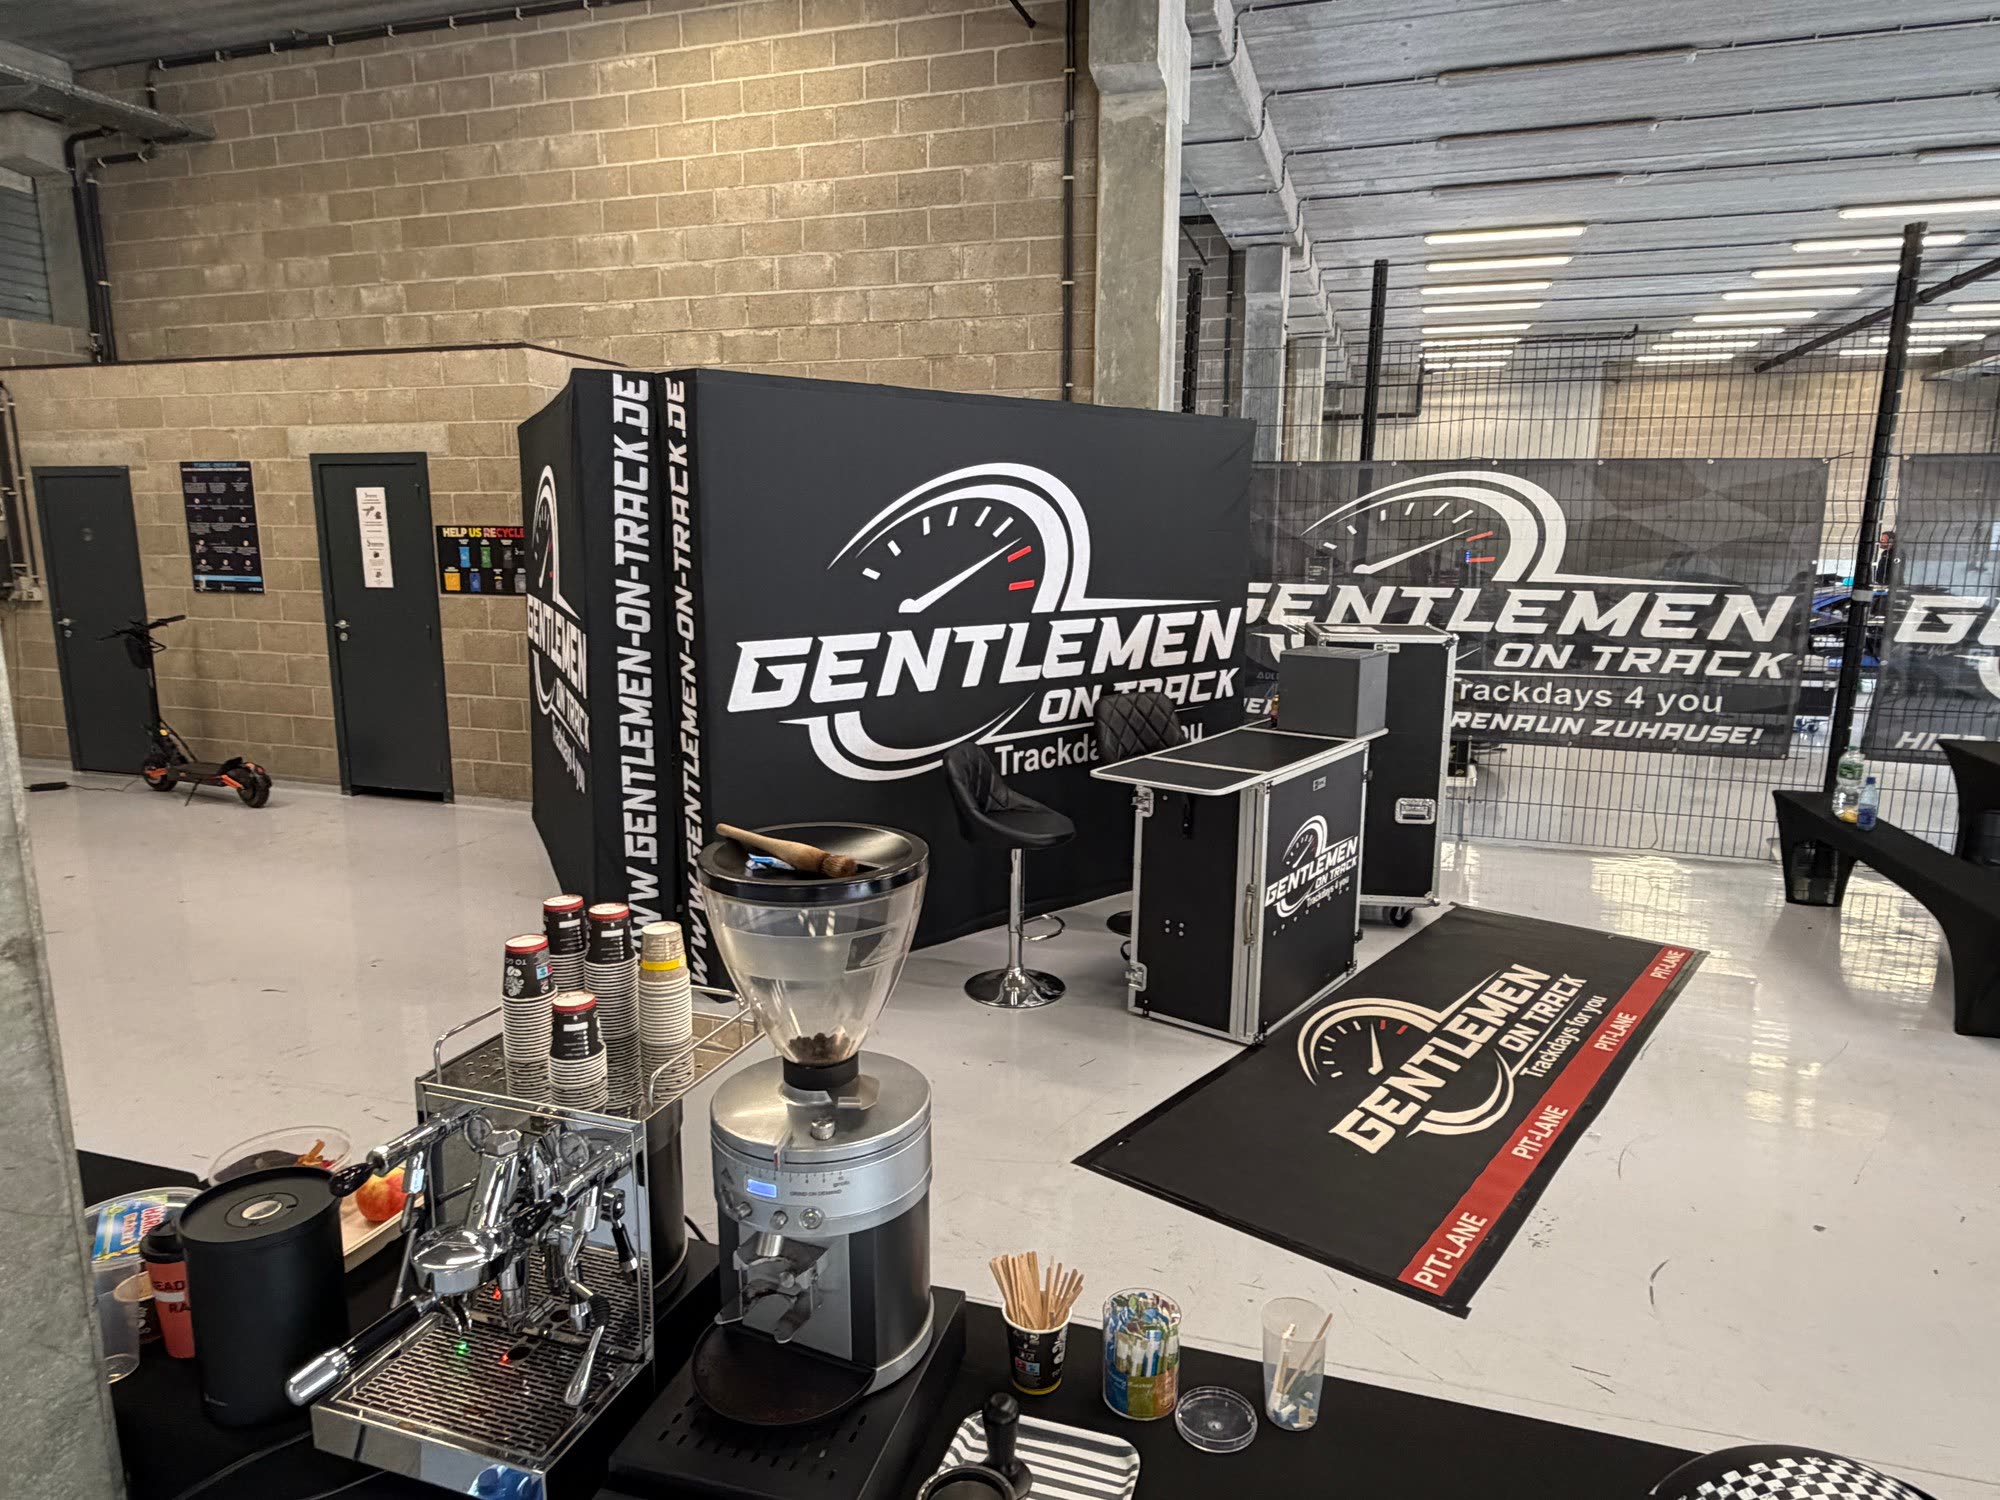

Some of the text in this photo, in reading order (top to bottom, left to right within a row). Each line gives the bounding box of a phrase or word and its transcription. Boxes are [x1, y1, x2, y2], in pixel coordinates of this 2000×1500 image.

[442, 527, 467, 538] HELP
[468, 527, 482, 538] US
[526, 593, 587, 700] GENTLEMEN
[612, 373, 662, 960] WW.GENTLEMEN-ON-TRACK.DE
[728, 607, 1242, 713] GENTLEMEN
[1494, 642, 1794, 679] ON TRACK
[665, 376, 708, 986] WWWGENTLEMEN-ON-TRACK.DE
[1624, 686, 1645, 709] 4
[1655, 692, 1723, 716] you
[1039, 684, 1102, 724] ON
[1450, 711, 1764, 745] RENALIN ZUHAUSE!
[994, 730, 1100, 777] Trackda
[1265, 836, 1359, 908] GENTLEMEN
[1314, 856, 1359, 890] ON TRACK
[1650, 949, 1687, 981] PIT-LANE
[1498, 973, 1588, 1053] ON TRACK
[1594, 1011, 1638, 1052] PIT-LANE
[1520, 995, 1608, 1078] Trackdays for you
[1329, 963, 1552, 1155] GENTLEMEN
[1511, 1104, 1569, 1161] PIT-LANE
[140, 1206, 166, 1240] HARI
[1413, 1211, 1488, 1290] PIT-LANE
[153, 1281, 185, 1291] EAD
[169, 1303, 192, 1313] RA
